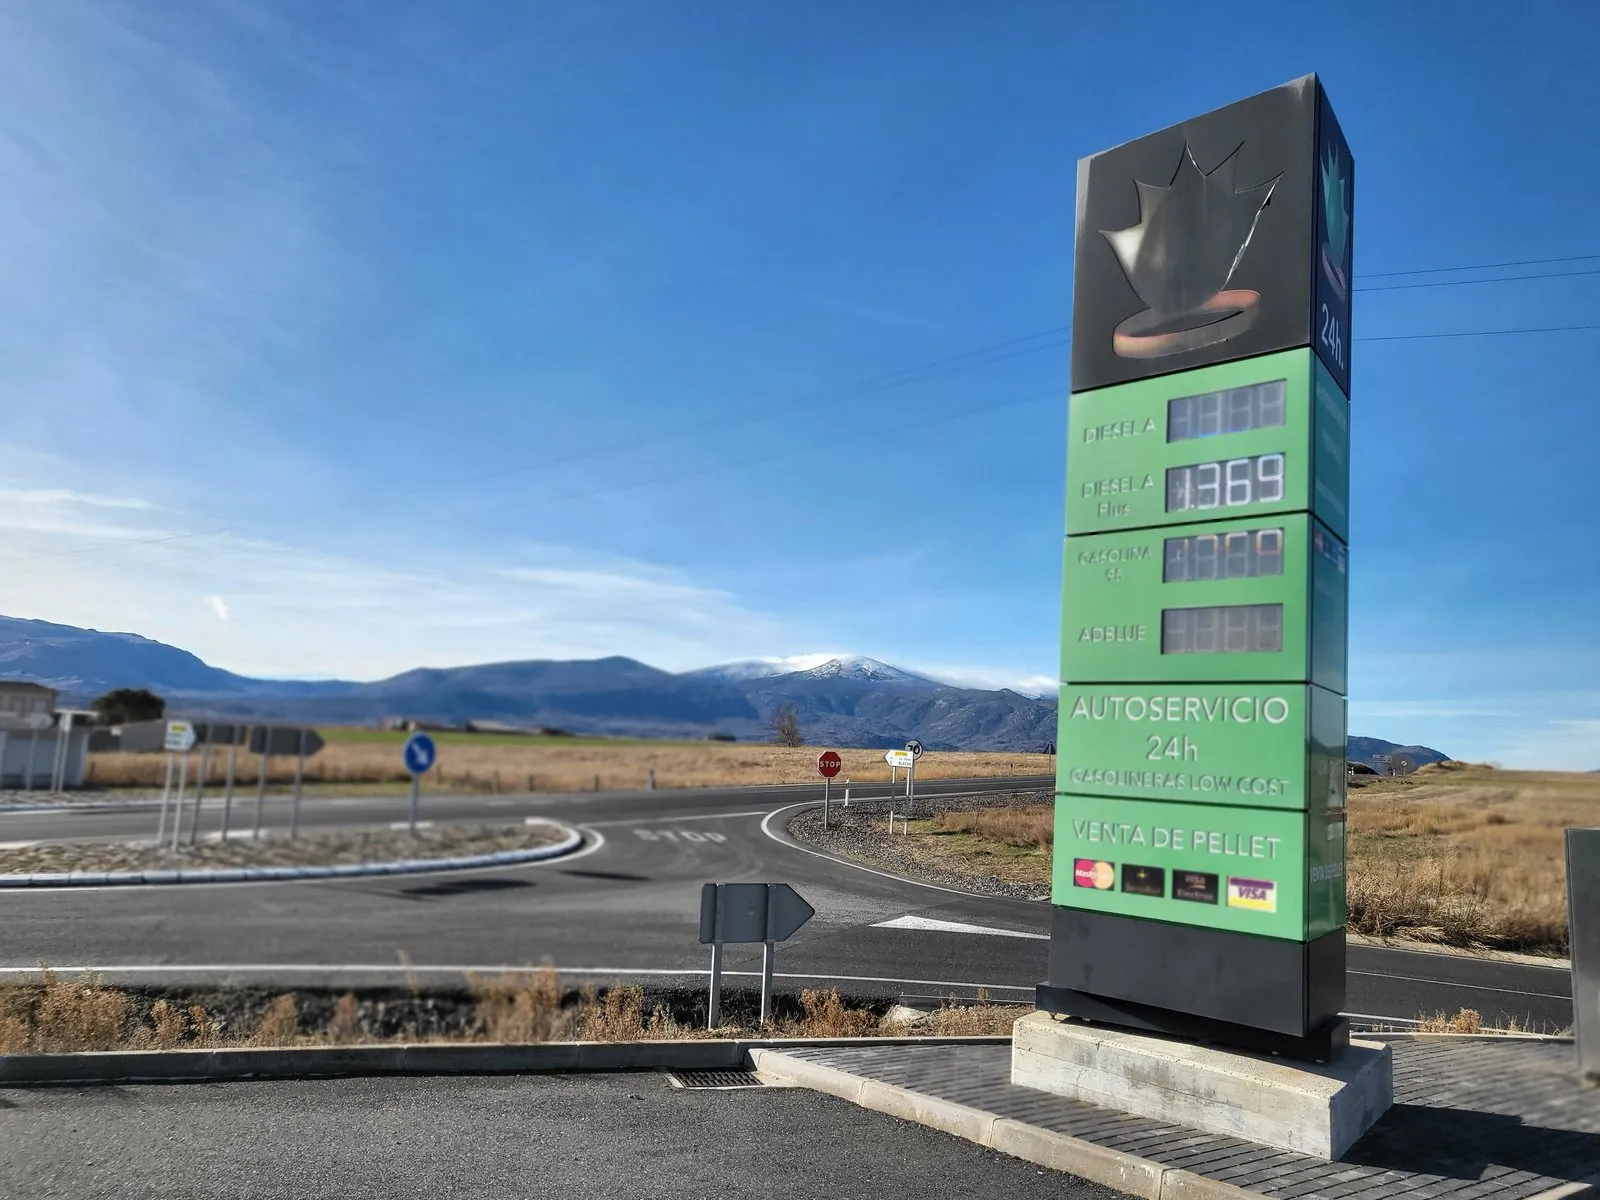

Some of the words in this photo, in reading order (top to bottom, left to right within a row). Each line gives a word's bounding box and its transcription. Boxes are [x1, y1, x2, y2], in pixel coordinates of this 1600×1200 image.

[1083, 420, 1139, 444] DIESEL
[1142, 417, 1156, 432] A
[1082, 478, 1139, 499] DIESEL
[1141, 474, 1154, 490] A
[1097, 501, 1131, 518] Plus
[1079, 546, 1153, 565] GASOLINA
[1079, 625, 1147, 643] ADBLUE
[1070, 696, 1290, 724] AUTOSERVICIO
[1146, 734, 1198, 762] 24h
[819, 760, 841, 768] STOP
[1069, 767, 1185, 790] GASOLINERAS
[1189, 774, 1231, 792] LOW
[1236, 776, 1290, 796] COST
[1072, 819, 1146, 847] VENTA
[1152, 826, 1184, 850] DE
[1191, 830, 1281, 859] PELLET
[1237, 886, 1267, 901] VISA
